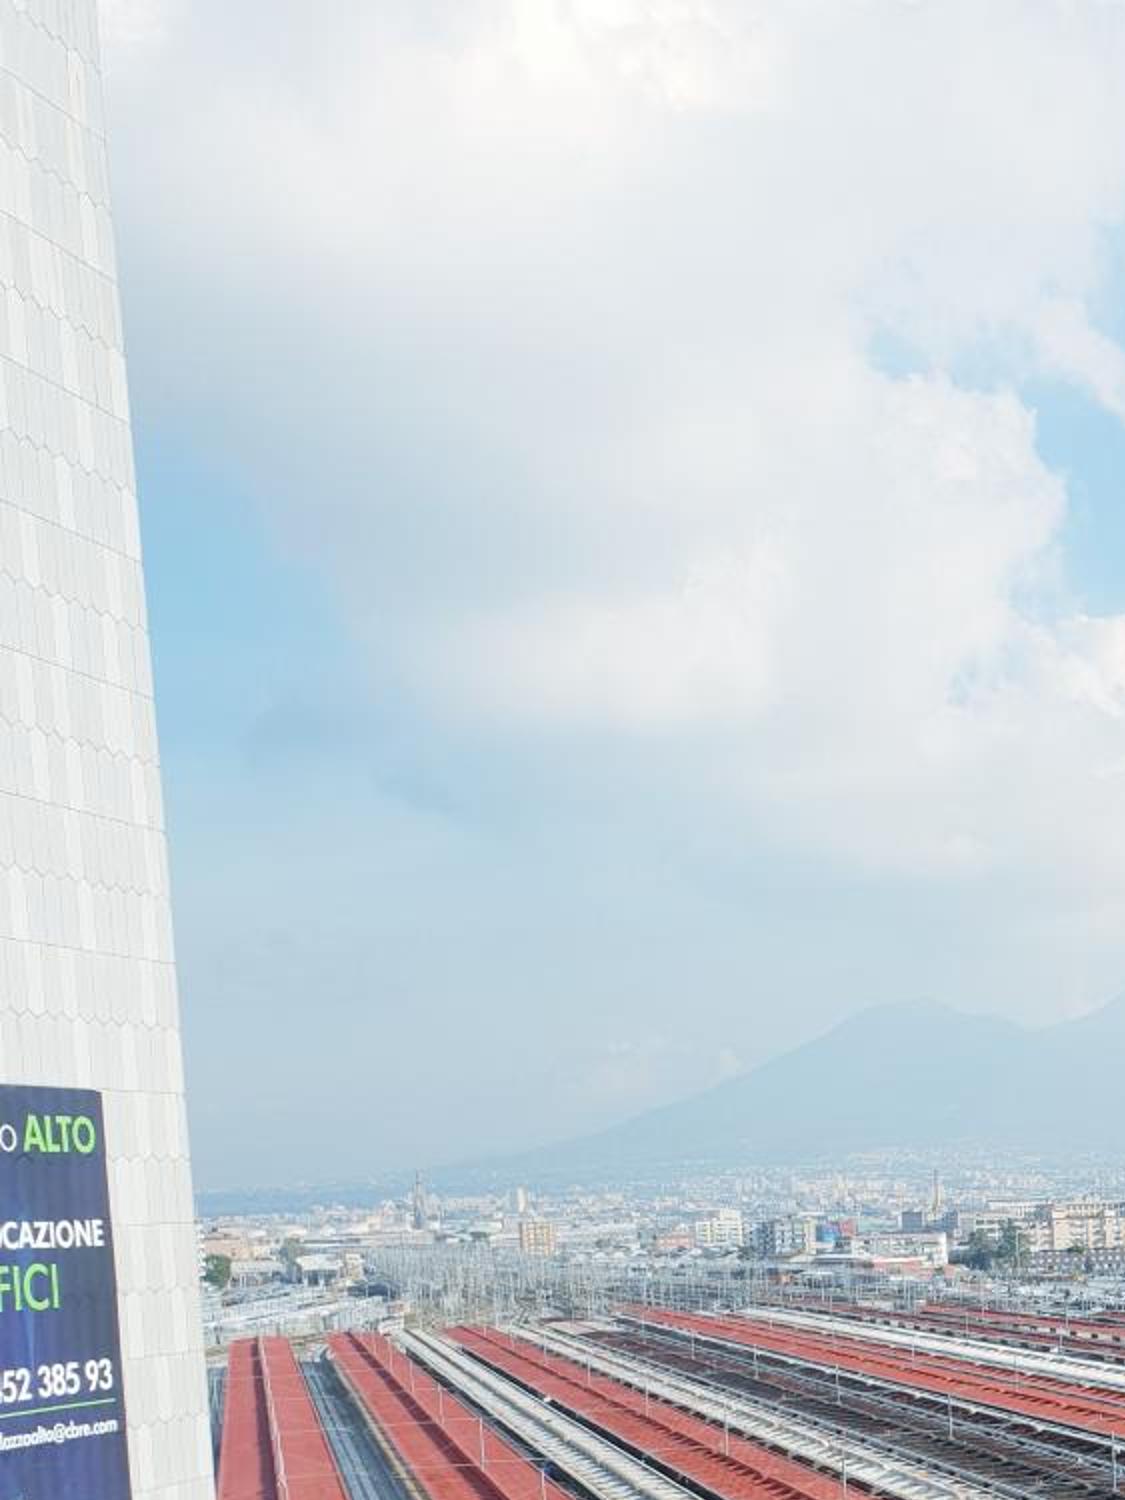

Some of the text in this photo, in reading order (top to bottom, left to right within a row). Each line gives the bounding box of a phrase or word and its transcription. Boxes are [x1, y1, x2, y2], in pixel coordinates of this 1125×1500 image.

[0, 1114, 96, 1153] O ALTO
[0, 1220, 105, 1250] CAZIONE
[0, 1263, 60, 1312] FICI
[0, 1358, 113, 1403] 52 385 93
